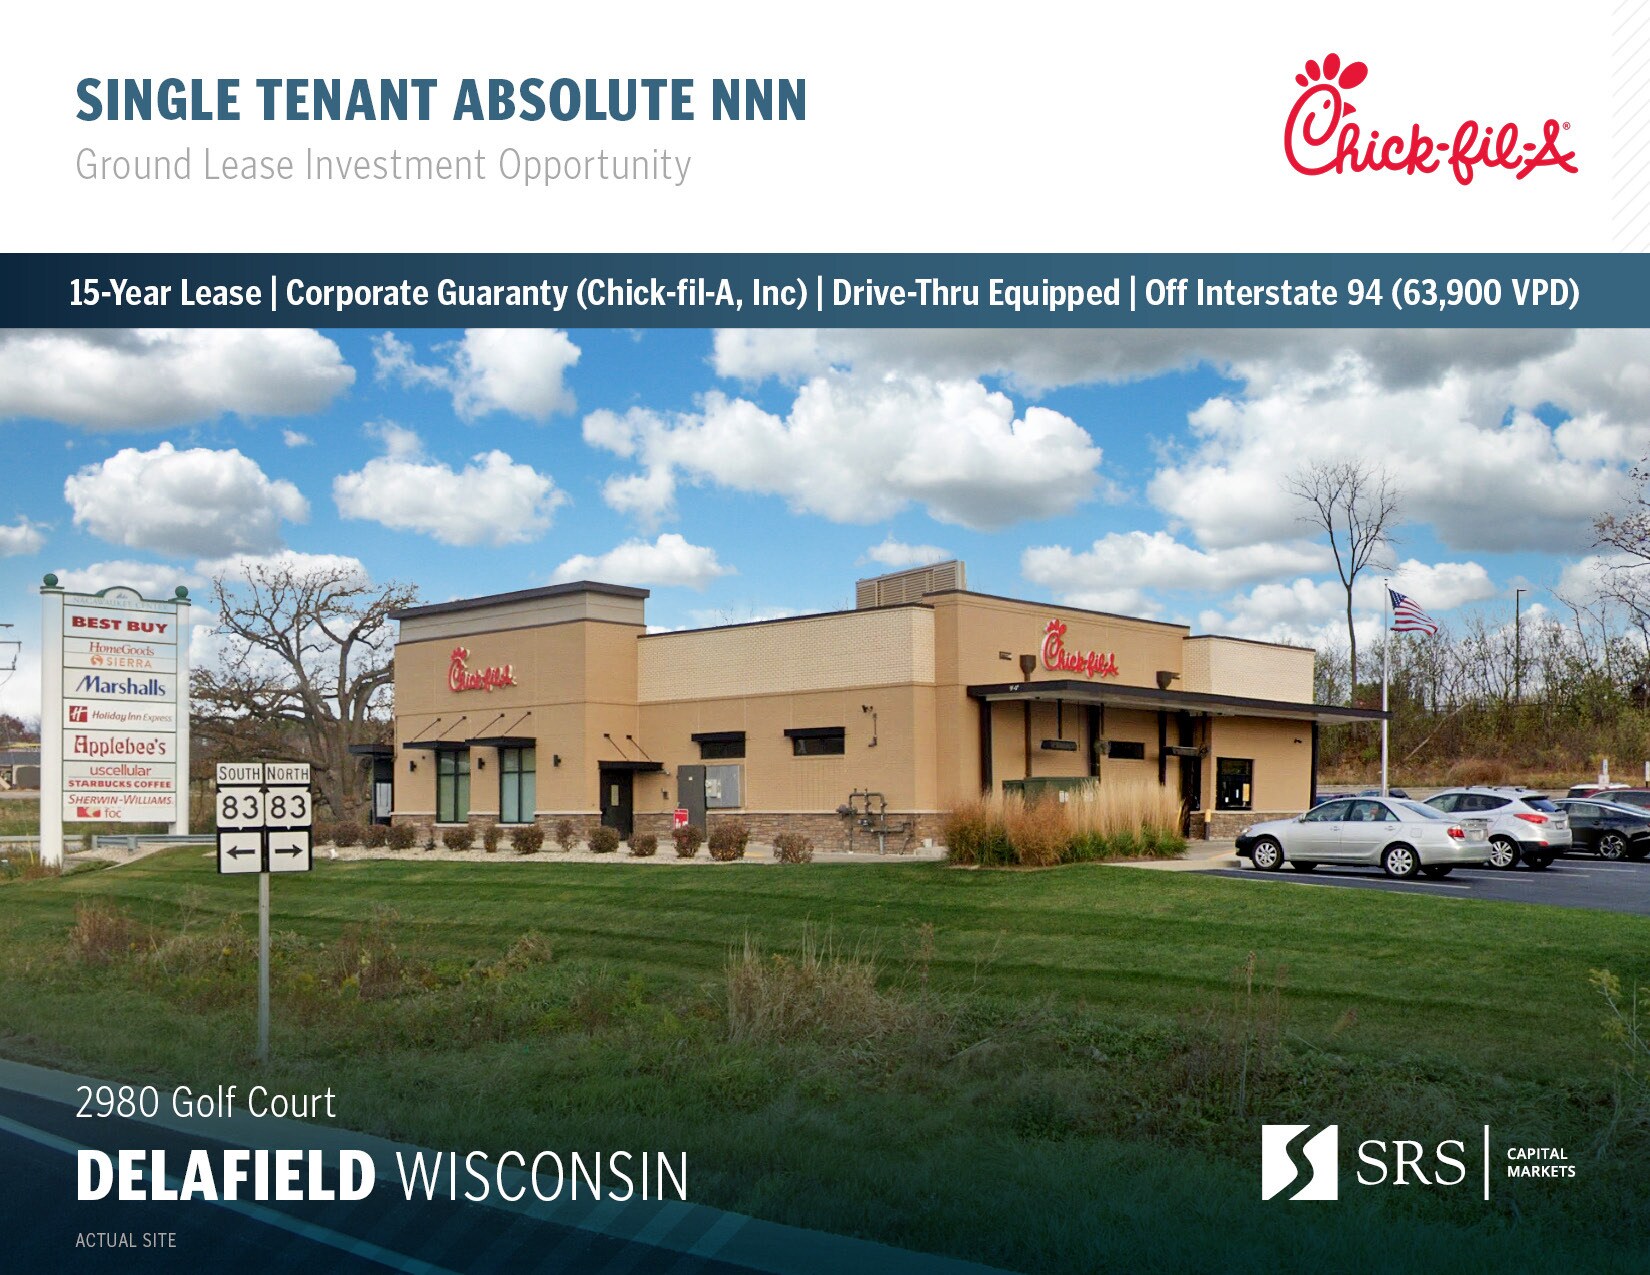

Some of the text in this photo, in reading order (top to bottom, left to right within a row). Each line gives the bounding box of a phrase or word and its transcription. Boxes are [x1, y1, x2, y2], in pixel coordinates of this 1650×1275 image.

[72, 616, 168, 634] BEST BUY
[89, 641, 155, 656] HomeGoods
[106, 657, 153, 668] SIERRA
[75, 675, 166, 697] Marshalls
[92, 710, 173, 723] Holiday Inn Express
[74, 735, 166, 758] Applebee's
[90, 764, 152, 776] uscellular
[219, 766, 260, 781] SOUTH
[267, 766, 309, 780] NORTH
[68, 780, 132, 788] STARBUCKS
[222, 795, 259, 820] 83
[270, 795, 306, 819] 83
